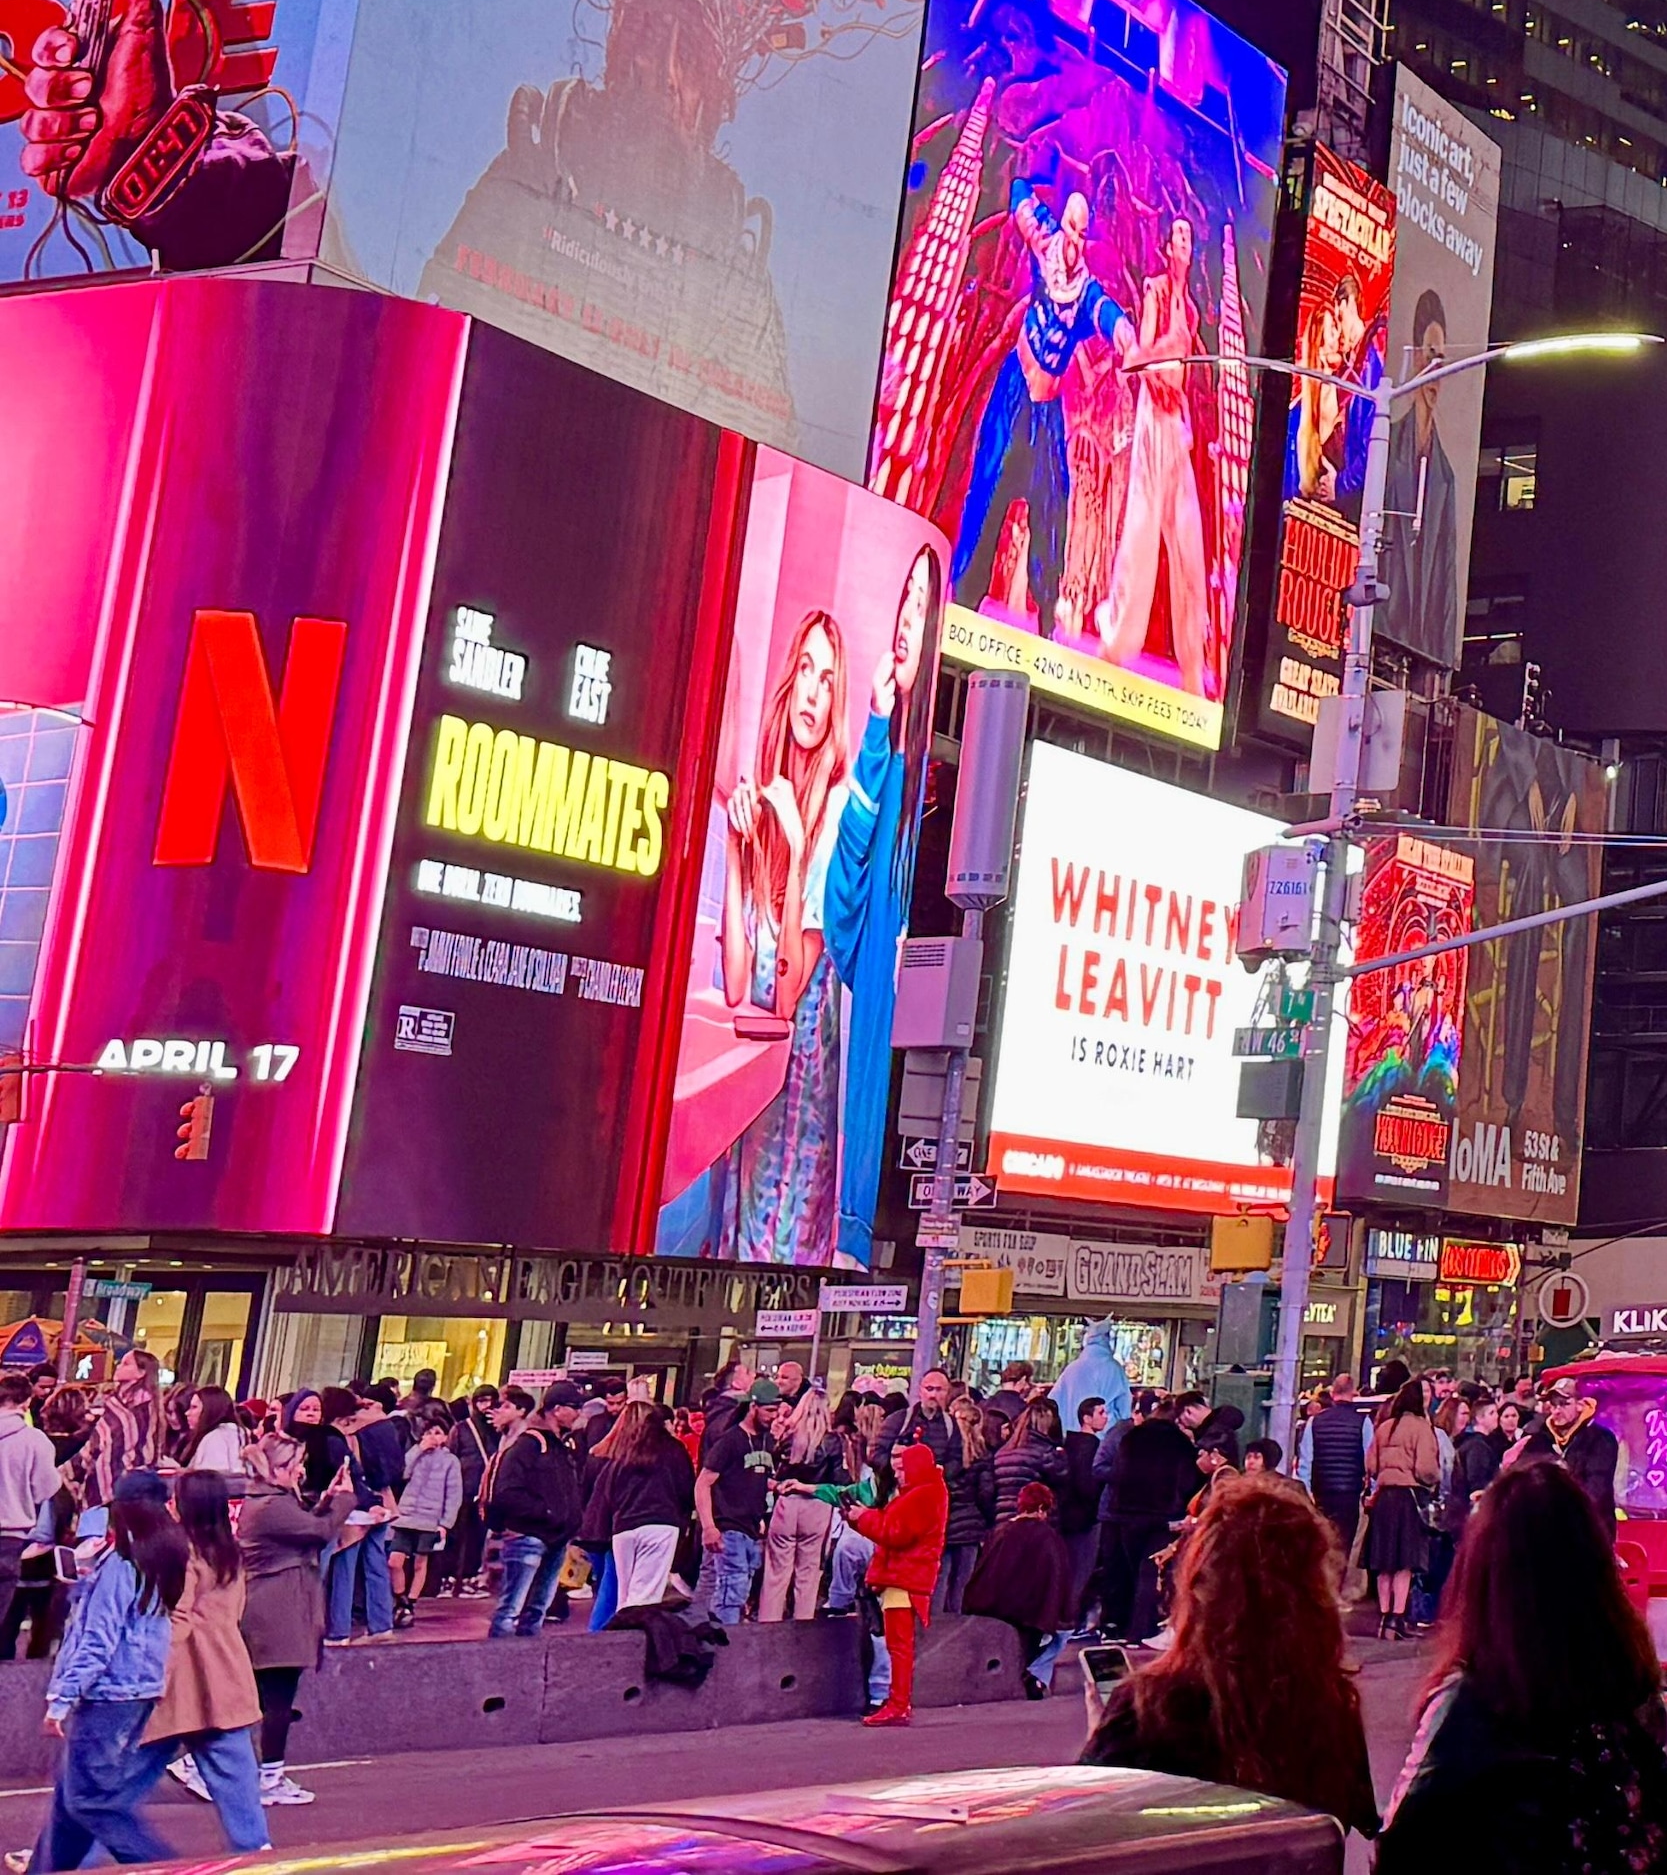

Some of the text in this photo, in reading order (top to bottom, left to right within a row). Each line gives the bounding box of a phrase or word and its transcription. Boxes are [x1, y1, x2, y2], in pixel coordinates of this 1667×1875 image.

[1401, 93, 1474, 186] Iconic art,
[1398, 133, 1430, 182] just
[1430, 171, 1440, 195] a
[1440, 167, 1469, 216] few
[1397, 176, 1445, 244] blocks
[1446, 228, 1483, 277] away
[949, 624, 973, 647] BOX
[978, 635, 1022, 665] OFFICE
[1067, 669, 1090, 690] AND
[1147, 696, 1172, 719] FEES
[427, 714, 669, 876] ROOMMATES
[1051, 857, 1240, 964] WHITNEY
[1053, 943, 1223, 1040] LEAVITT
[1288, 992, 1295, 1014] 7
[100, 1039, 299, 1081] APRIL 17
[1071, 1036, 1194, 1083] IS ROXIE HART
[1268, 1031, 1286, 1053] 46
[1523, 1130, 1538, 1158] 53
[957, 1185, 982, 1196] WAY
[1522, 1162, 1566, 1195] Fifth Ave
[1378, 1231, 1413, 1259] BLUE
[96, 1283, 147, 1300] Broadway
[286, 1244, 812, 1309] AMERICAN EAGLE OUTFITTERS
